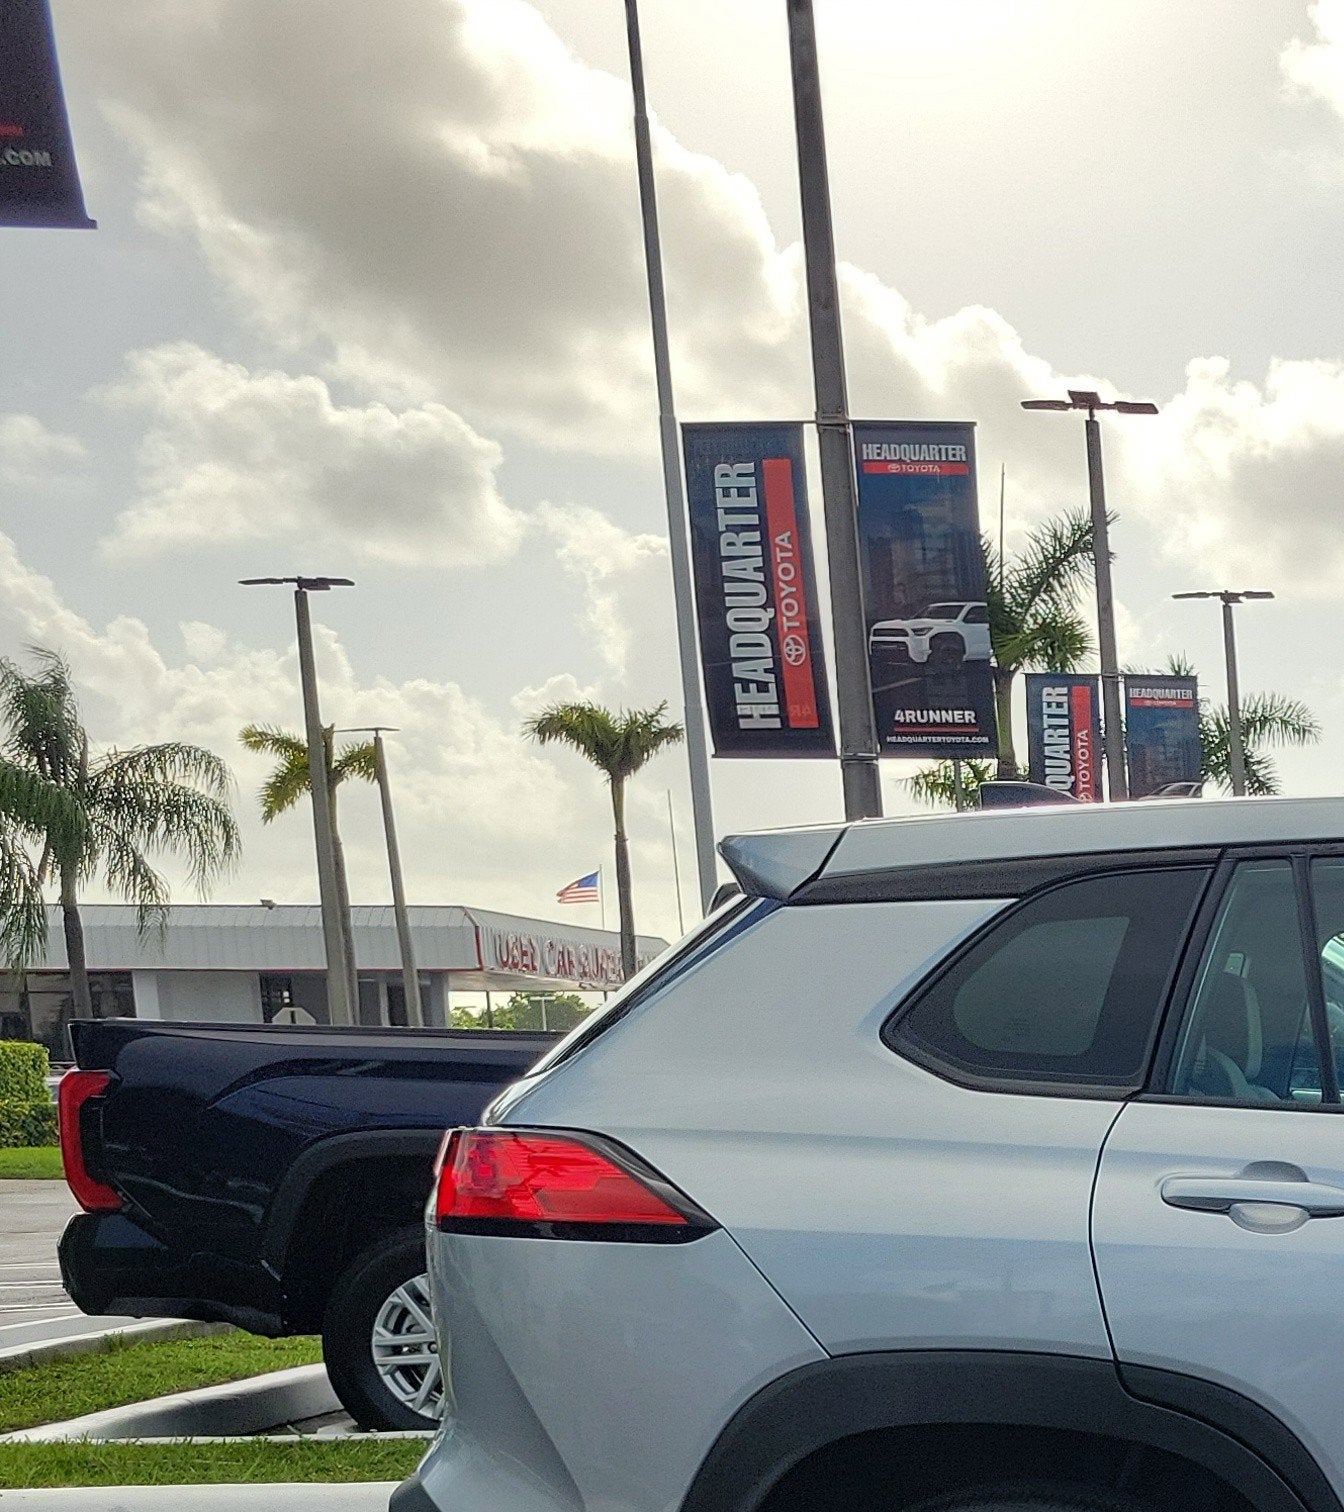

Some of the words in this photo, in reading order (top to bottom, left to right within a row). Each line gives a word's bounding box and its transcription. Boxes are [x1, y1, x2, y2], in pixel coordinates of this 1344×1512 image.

[862, 444, 967, 462] HEADQUARTER
[902, 464, 940, 472] TOYOTA
[714, 462, 782, 729] HEADQUARTER
[774, 530, 800, 632] TOYOTA
[1129, 688, 1193, 700] HEADQUARTER
[894, 710, 977, 723] 4RUNNER
[1042, 686, 1076, 797] QUARTER
[1077, 729, 1091, 790] TOYOTA
